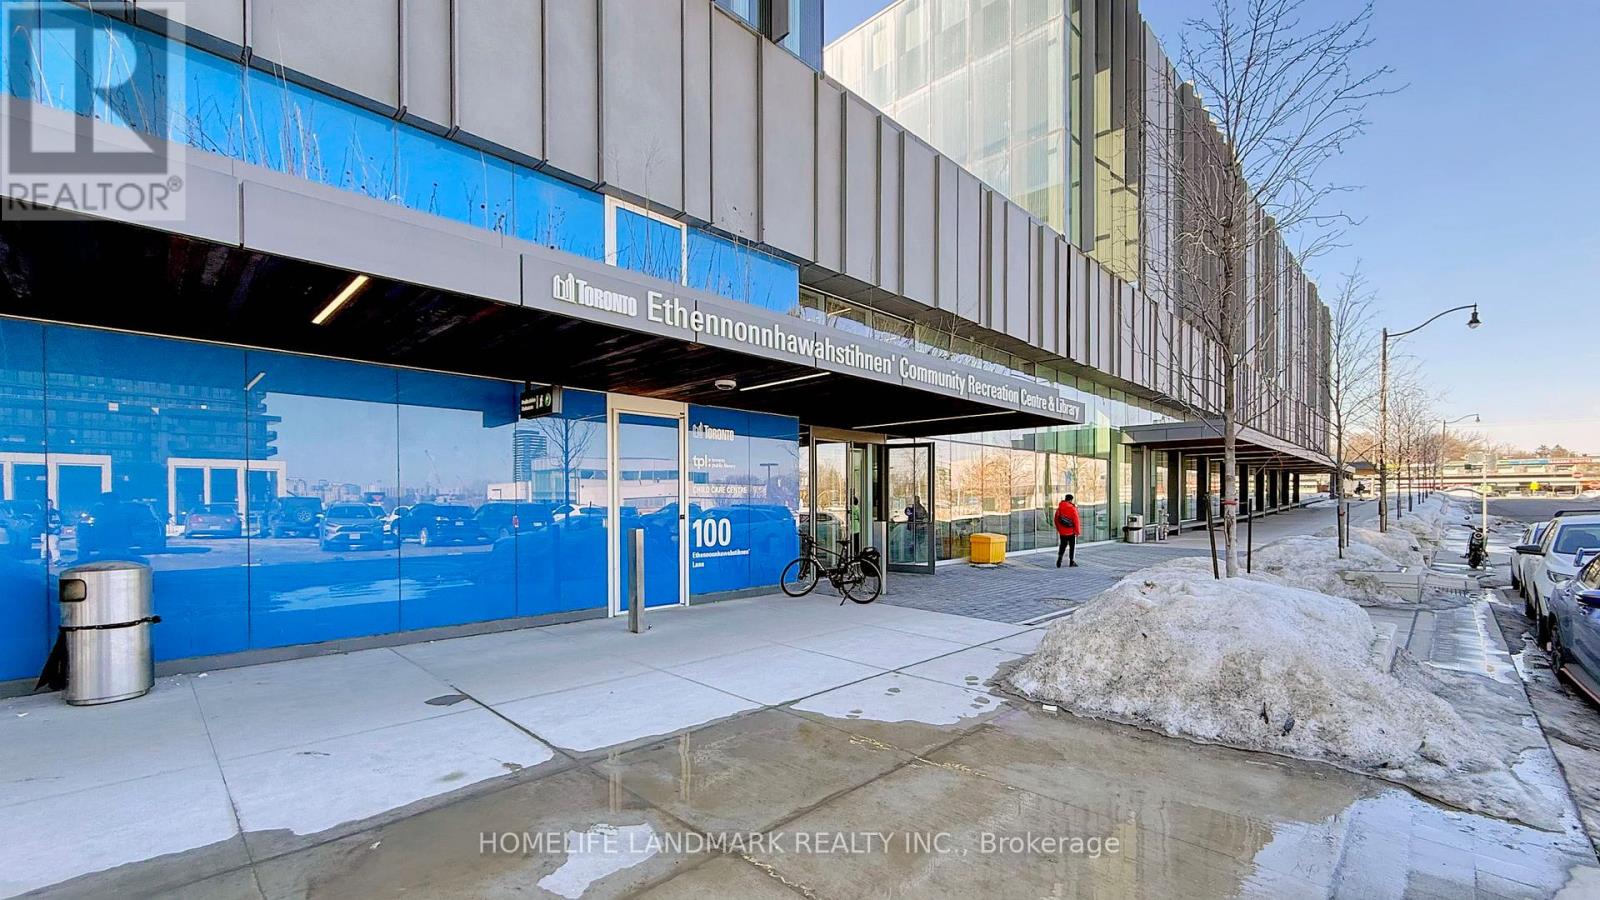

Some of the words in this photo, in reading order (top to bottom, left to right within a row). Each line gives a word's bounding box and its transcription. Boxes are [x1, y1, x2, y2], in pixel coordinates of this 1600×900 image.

[577, 278, 638, 317] TORONTO
[900, 358, 967, 394] Community
[968, 374, 1019, 404] Recreation
[1020, 388, 1048, 411] Centre
[1047, 395, 1056, 412] &
[1055, 397, 1081, 421] Library
[704, 425, 735, 442] TORONTO
[711, 486, 726, 494] CARE
[692, 518, 732, 548] 100
